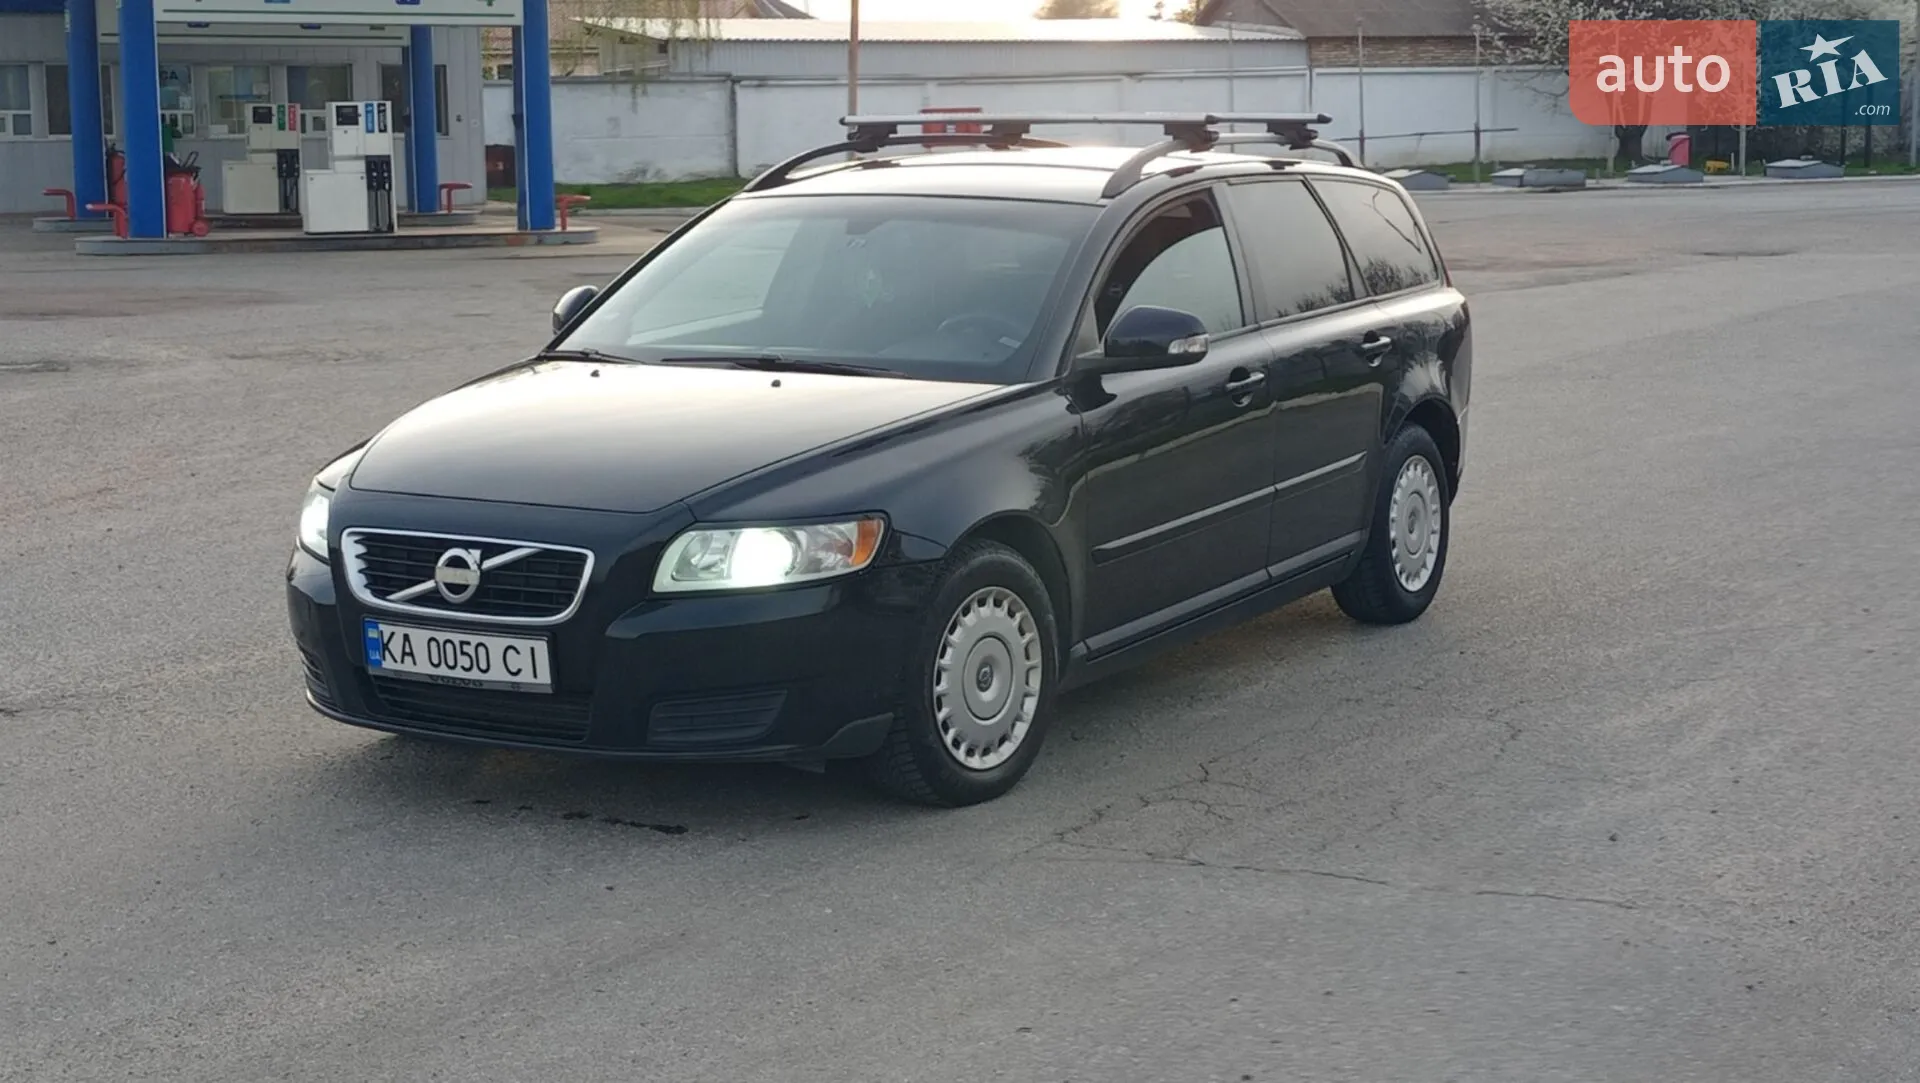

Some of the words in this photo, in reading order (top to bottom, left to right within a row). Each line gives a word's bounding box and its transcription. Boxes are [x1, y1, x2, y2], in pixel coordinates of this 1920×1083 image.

[380, 630, 417, 666] KA
[427, 636, 491, 674] 0050
[502, 645, 538, 679] CI
